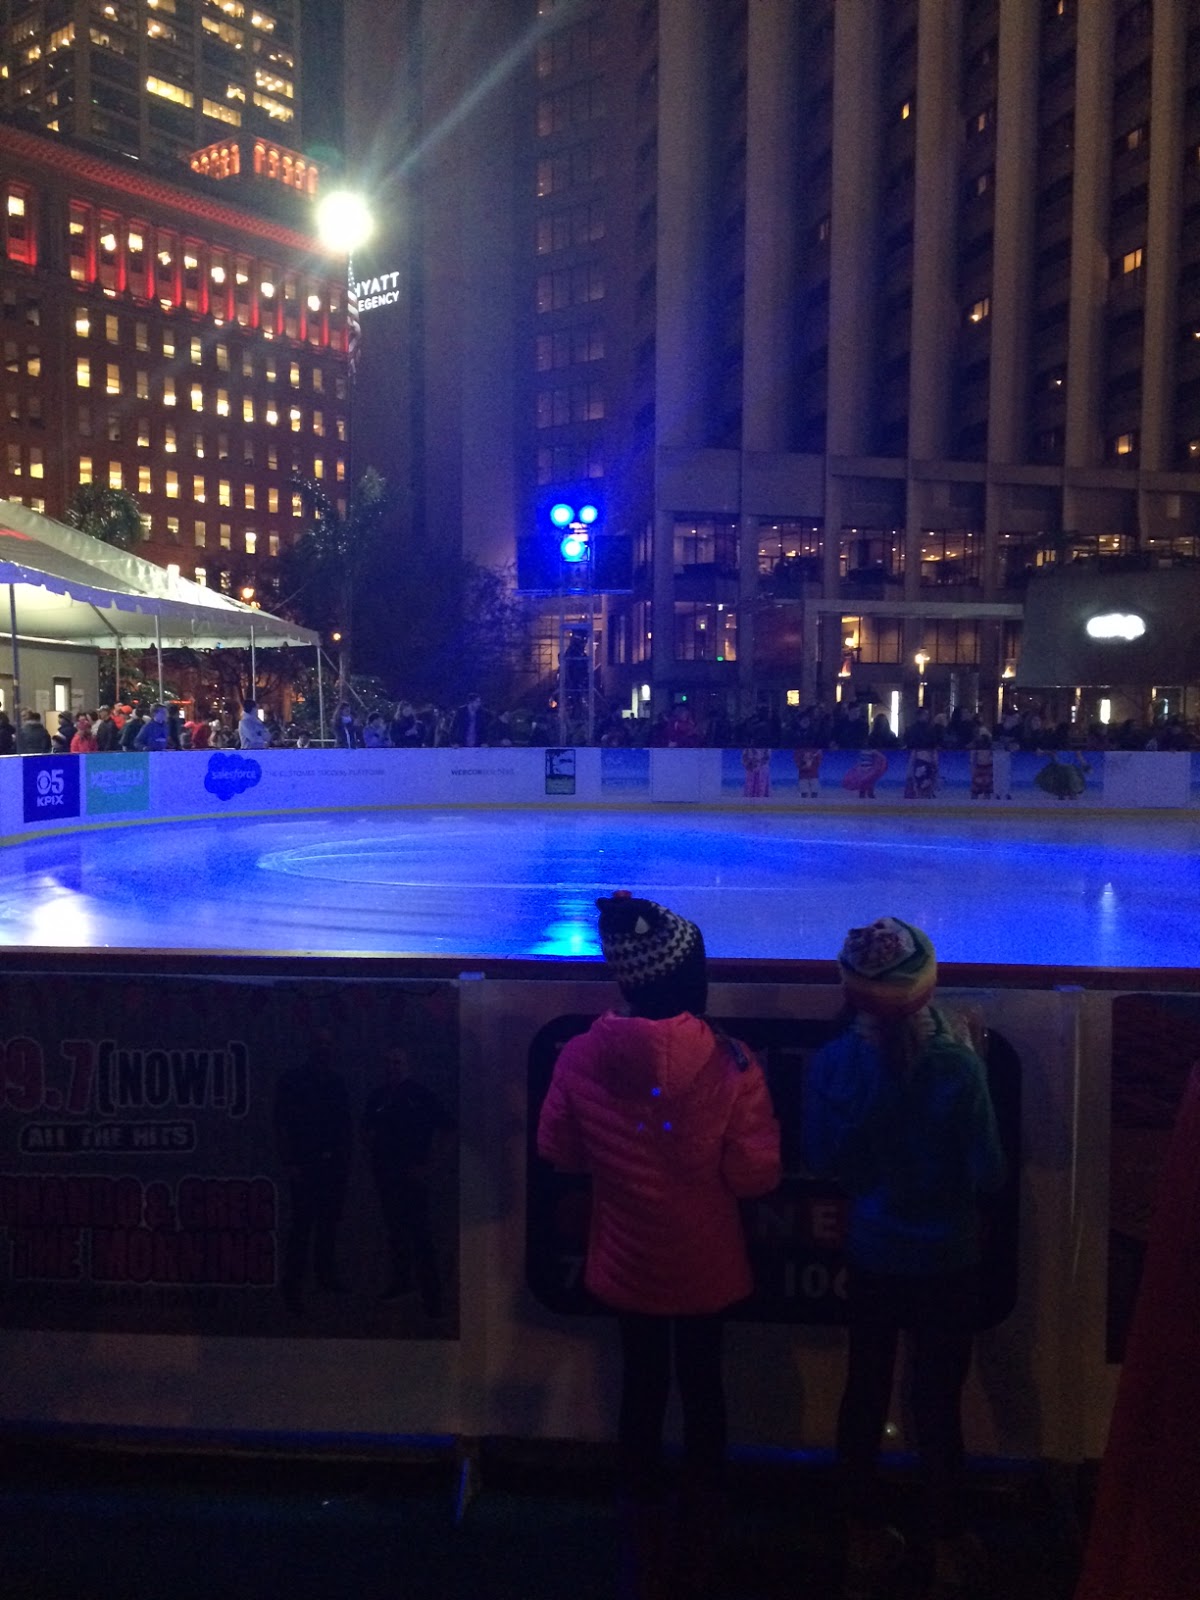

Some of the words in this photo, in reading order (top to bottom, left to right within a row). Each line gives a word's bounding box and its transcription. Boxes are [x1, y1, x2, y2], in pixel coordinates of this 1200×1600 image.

[357, 290, 400, 312] EGENCY
[37, 795, 64, 808] KPIX
[80, 1127, 121, 1148] THE
